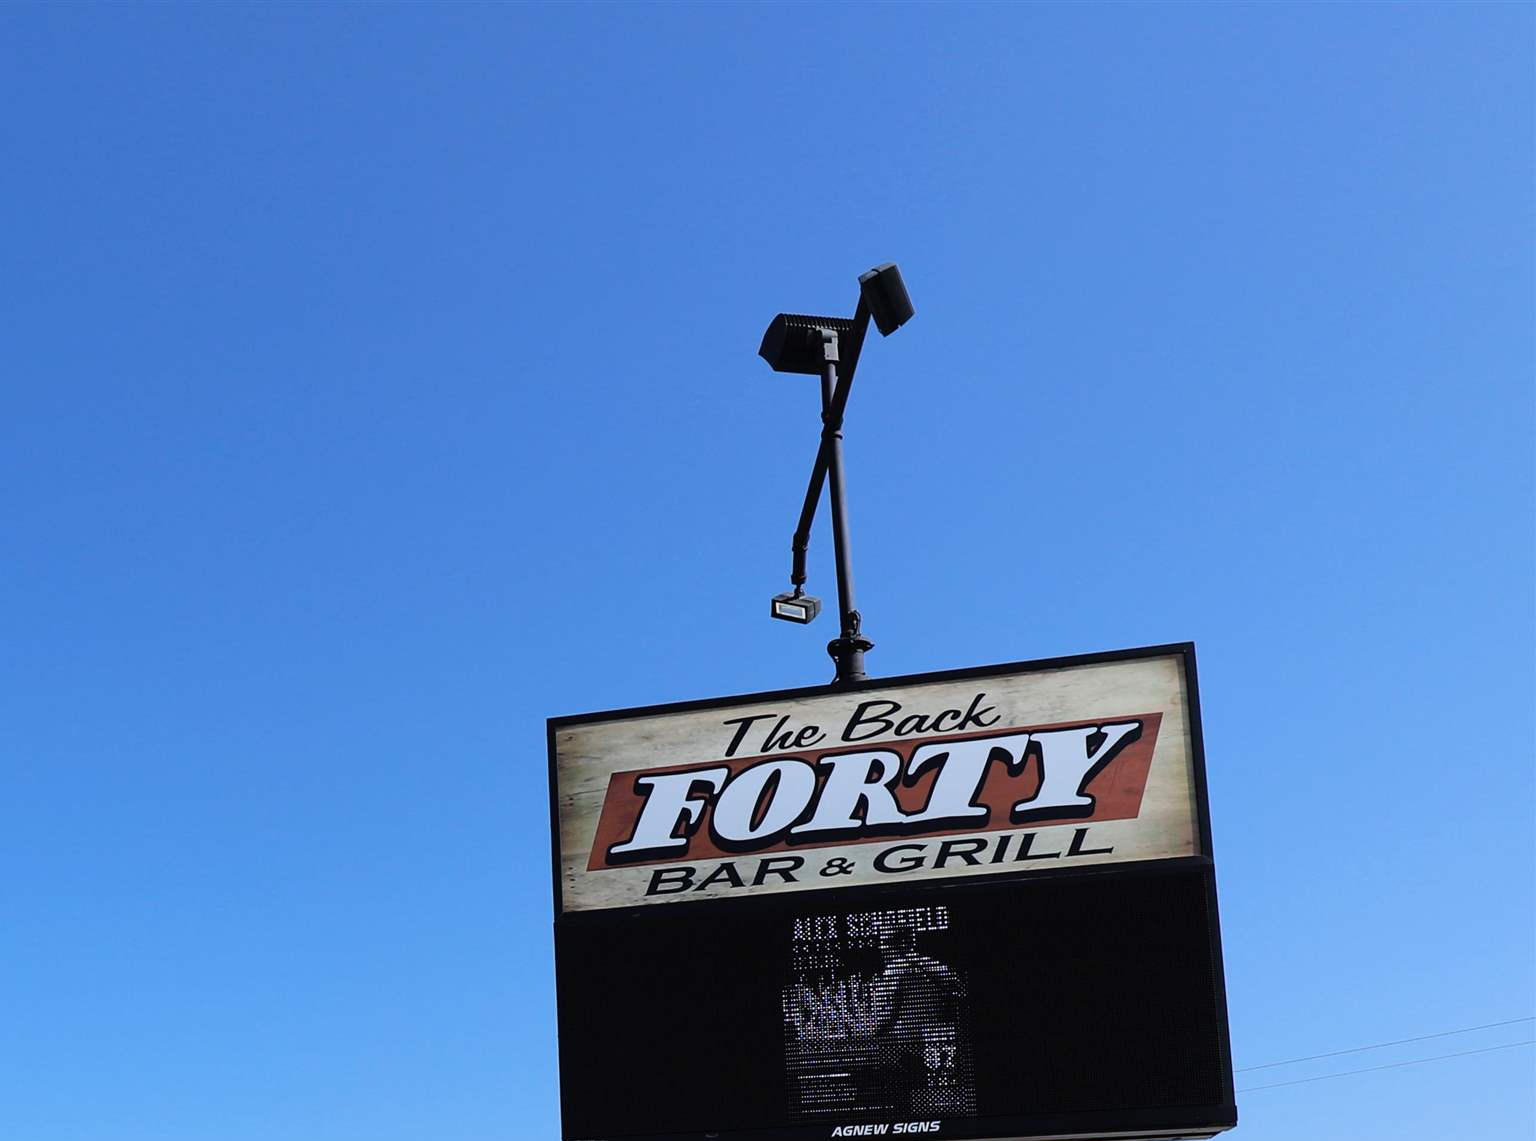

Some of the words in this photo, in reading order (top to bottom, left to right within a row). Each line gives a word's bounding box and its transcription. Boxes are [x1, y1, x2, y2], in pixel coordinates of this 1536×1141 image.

[723, 714, 827, 757] The
[840, 693, 1001, 742] Back
[609, 720, 1142, 856] FORTY
[645, 855, 805, 897] BAR
[819, 857, 855, 876] &
[872, 828, 1114, 873] GRILL
[831, 1123, 889, 1137] AGNEW
[892, 1121, 941, 1134] SIGNS
